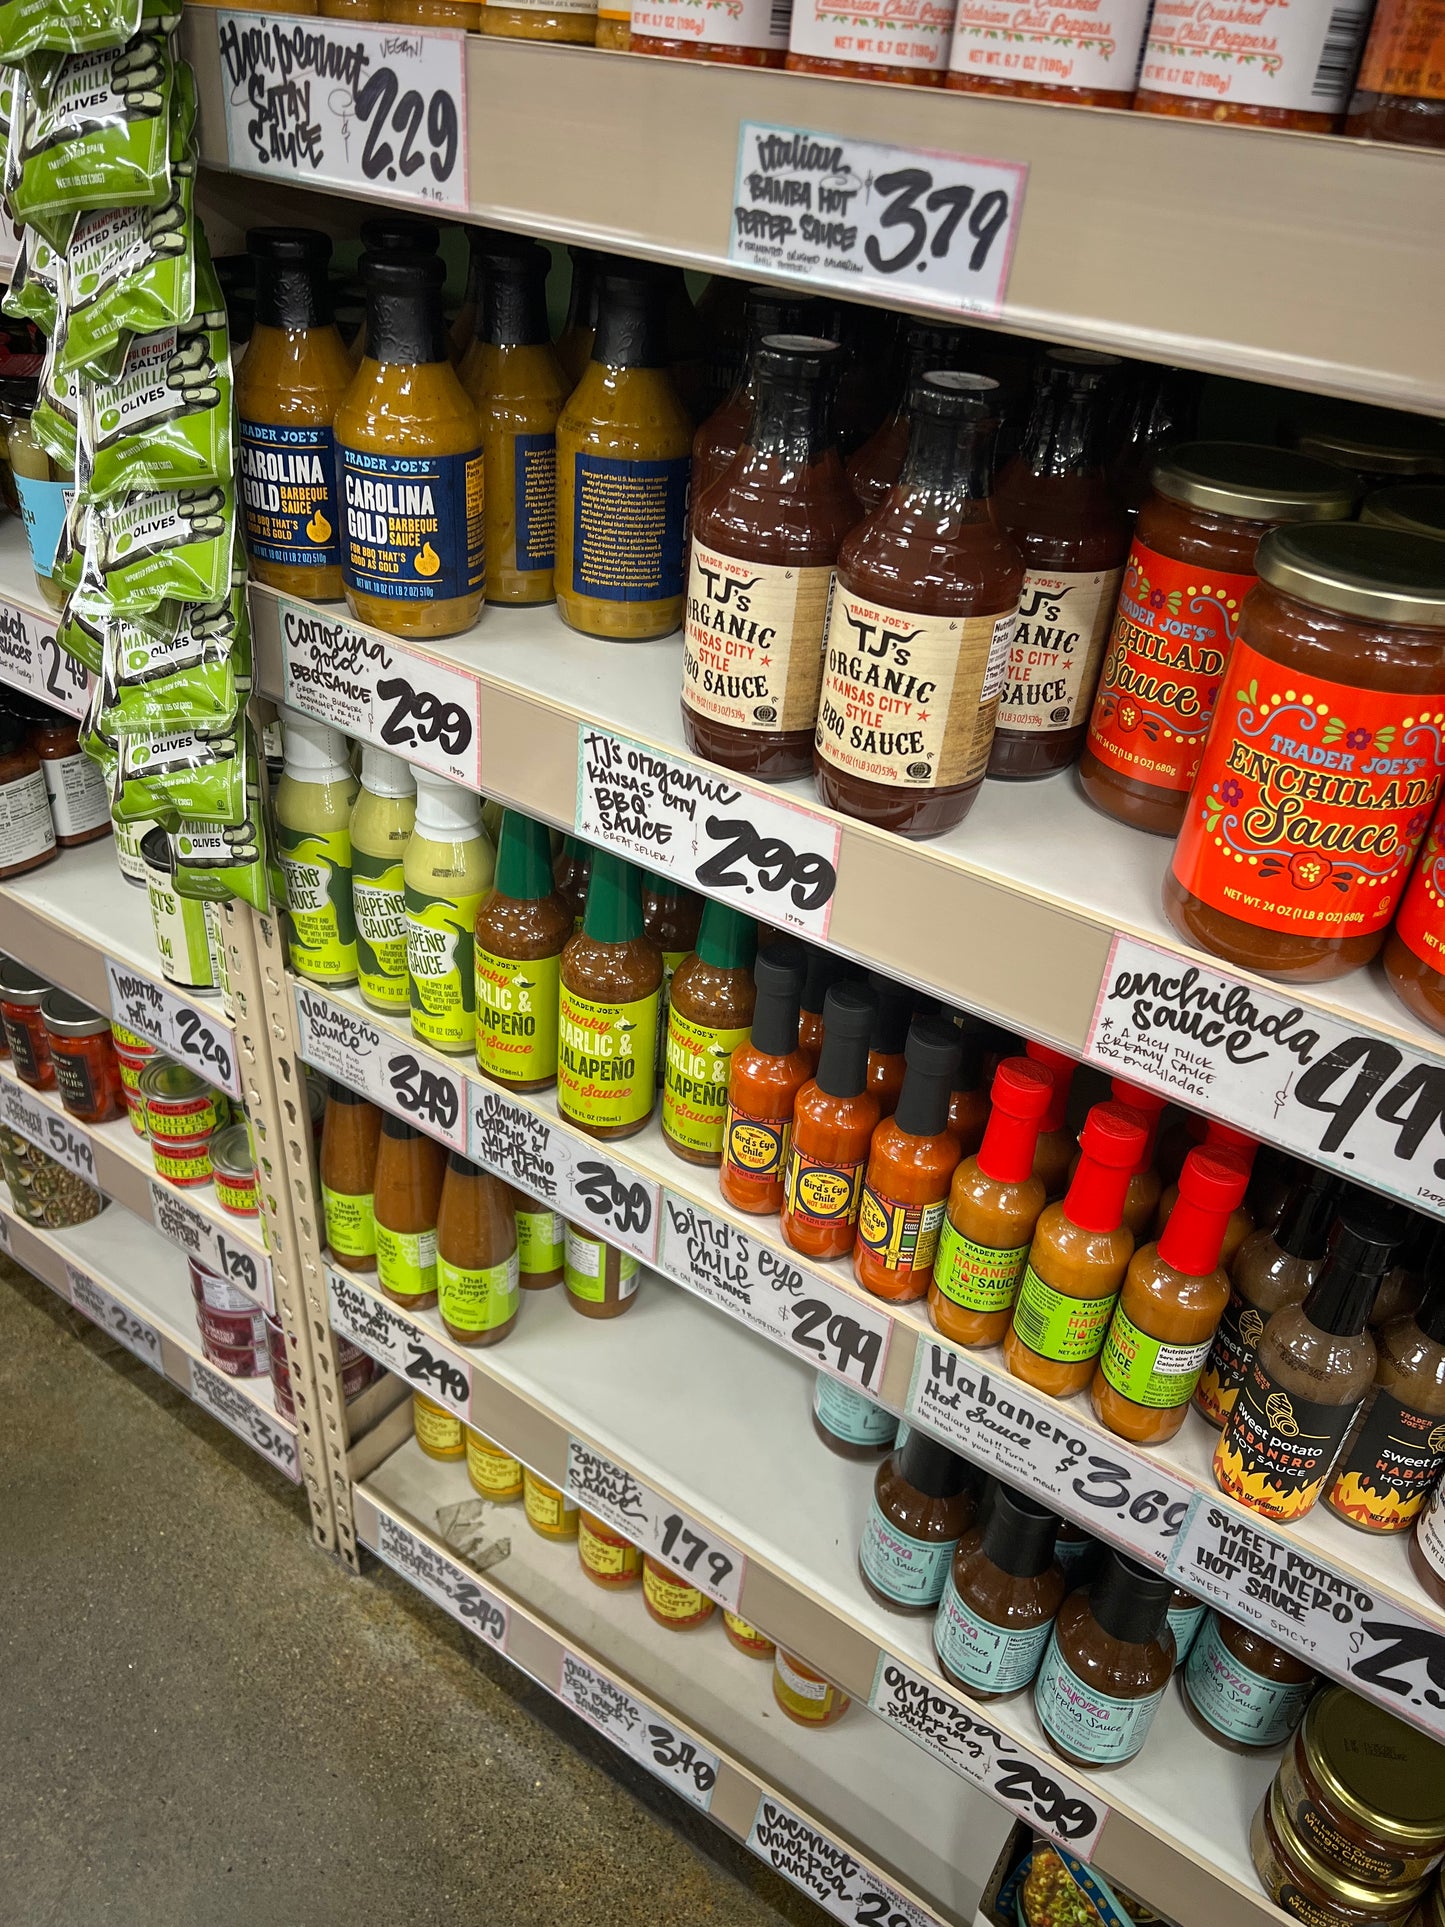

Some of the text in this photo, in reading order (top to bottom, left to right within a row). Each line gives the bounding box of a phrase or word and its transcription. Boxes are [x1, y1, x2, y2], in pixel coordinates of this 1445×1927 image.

[59, 91, 108, 118] OLIVES
[249, 72, 311, 135] SATAY
[249, 119, 324, 168] SAUCE
[750, 174, 858, 216] BAMBA HOT
[72, 229, 109, 257] PITTED
[800, 214, 858, 251] SAUCE
[152, 336, 174, 355] OLIVES
[121, 387, 165, 414] OLIVES
[344, 451, 430, 472] TRADER JOE'S
[345, 474, 434, 514] CAROLINA
[112, 495, 177, 535] MANZANILLA
[133, 516, 176, 538] OLIVES
[348, 508, 438, 544] GOLD BARBEQUE
[350, 543, 406, 562] FOR BBQ THAT'S
[389, 533, 421, 547] SAUCE
[351, 556, 399, 573] GOOD AS GOLD
[290, 663, 372, 704] BBQ SAUCE
[830, 649, 937, 704] ORGANIC
[832, 678, 912, 715] KANSAS CITY
[822, 700, 924, 756] BBQ SAUCE
[846, 703, 883, 728] STYLE
[151, 738, 193, 755] OLIVES
[1271, 735, 1417, 775] TRADER JOE'S
[587, 762, 696, 821] KANSAS CITY
[627, 751, 741, 805] organic
[1227, 740, 1440, 810] ENCHILADA
[594, 788, 648, 817] BBQ
[1244, 786, 1398, 856] Sauce
[192, 837, 221, 848] OLIVES
[600, 812, 672, 844] SAUCE
[603, 832, 631, 848] GREAT
[1223, 887, 1364, 923] NET WT. 24 OZ (1 LB 8 OZ) 680g
[363, 918, 407, 939] SAUCE
[560, 1015, 633, 1057] GARLIC &
[561, 1000, 611, 1035] Chunky
[1108, 968, 1321, 1065] enchilada
[1132, 1000, 1269, 1064] sauce
[560, 1050, 635, 1081] JALAPEÑO
[1102, 1033, 1217, 1083] CREAMY SAUCE
[1121, 1028, 1216, 1070] A RICH THICK
[560, 1066, 633, 1099] Hot Sauce
[149, 1114, 205, 1127] GREEN
[1295, 1036, 1445, 1177] 4.4
[481, 1142, 509, 1168] HOT
[512, 1160, 557, 1196] SAUCE
[804, 1179, 848, 1198] Bird's Eye
[807, 1199, 838, 1210] HOT SAUCE
[813, 1192, 835, 1203] Chile
[667, 1200, 804, 1296] bird's eye
[965, 1241, 1022, 1259] TRADER JOE'S
[458, 1288, 489, 1296] ginger
[462, 1276, 483, 1284] Thai
[690, 1263, 752, 1305] HOT SAUCE
[1161, 1347, 1194, 1359] Nutrition
[925, 1379, 1032, 1450] Hot Sauce
[931, 1344, 1088, 1456] Habanero
[920, 1397, 970, 1434] Incendiary
[1004, 1447, 1025, 1462] Turn
[1028, 1462, 1038, 1471] up
[1234, 1412, 1316, 1468] HABANERO
[1239, 1401, 1323, 1457] sweet potato
[918, 1407, 1061, 1495] the heat on your favorite meals!
[1233, 1429, 1306, 1477] HOT SAUCE
[1208, 1508, 1374, 1612] SWEET POTATO
[1219, 1536, 1353, 1623] HABANERO
[1197, 1546, 1308, 1622] HOT SAUCE
[1190, 1571, 1317, 1651] SWEET AND SPICY!
[564, 1672, 589, 1695] RED
[1087, 1715, 1121, 1732] Sauce
[1304, 1814, 1393, 1875] Mango Chutney
